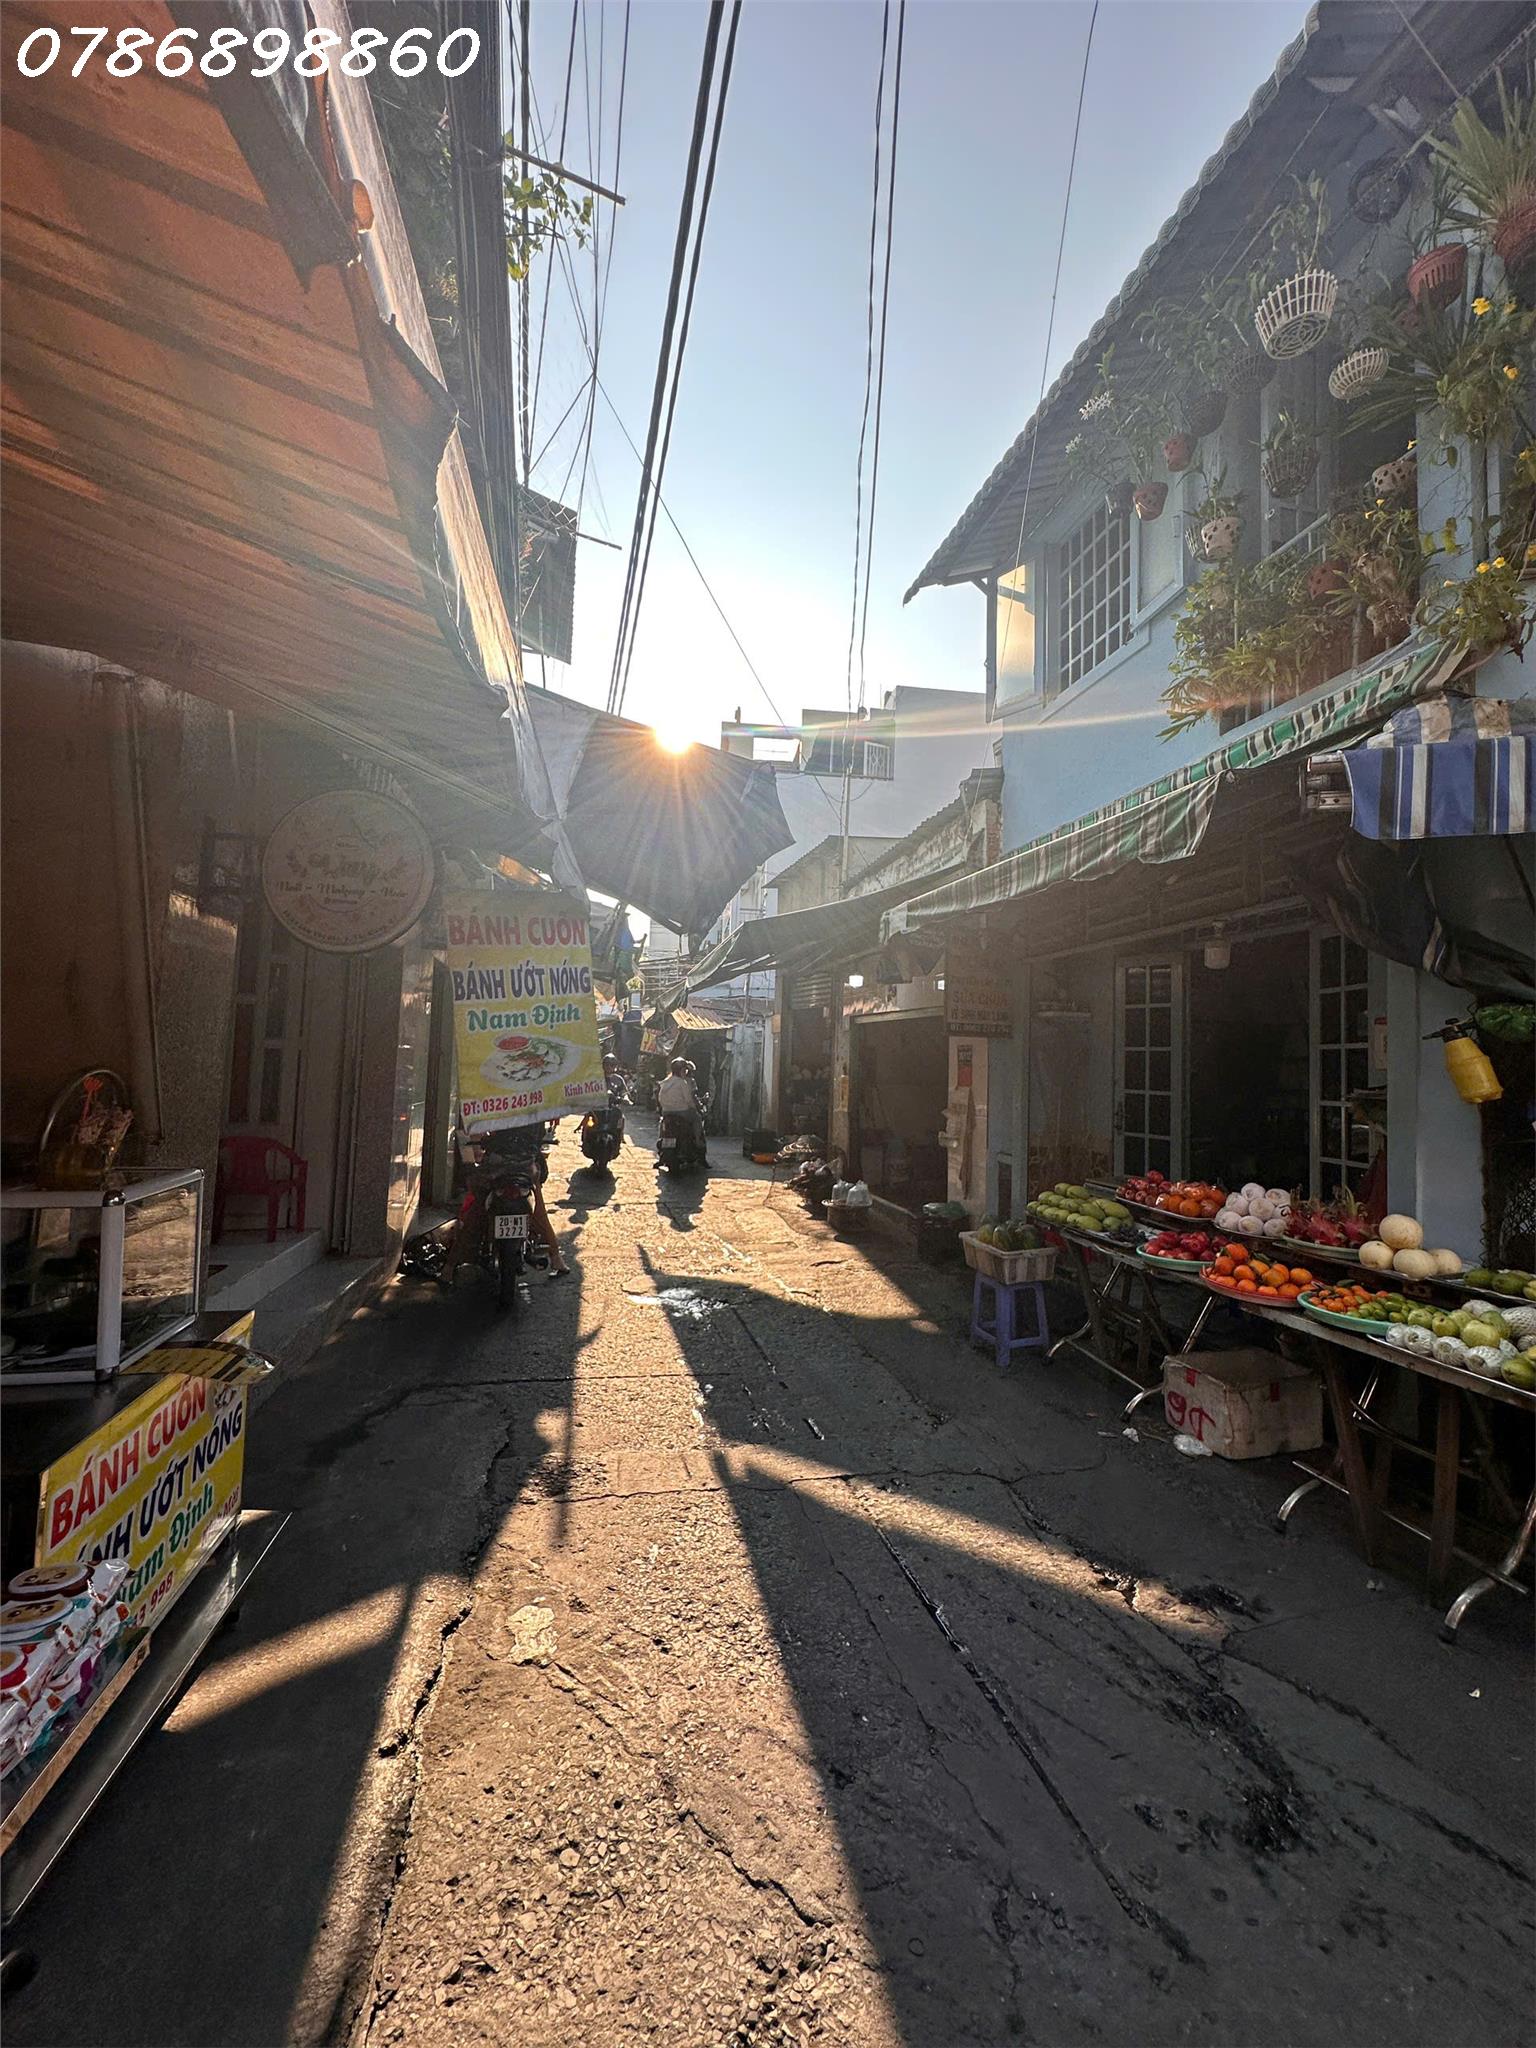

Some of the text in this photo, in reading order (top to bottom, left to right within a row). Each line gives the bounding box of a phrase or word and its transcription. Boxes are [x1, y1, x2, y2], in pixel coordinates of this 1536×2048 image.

[453, 959, 592, 1001] BÁNH ƯỚT NÓNG
[467, 1003, 581, 1032] Nam Định
[482, 1097, 509, 1112] 0326
[511, 1094, 528, 1108] 243
[50, 1430, 140, 1549] BÁNH
[140, 1455, 190, 1536] ƯỚT
[192, 1401, 243, 1484] NÓNG
[169, 1482, 213, 1553] Định
[151, 1570, 174, 1612] 998
